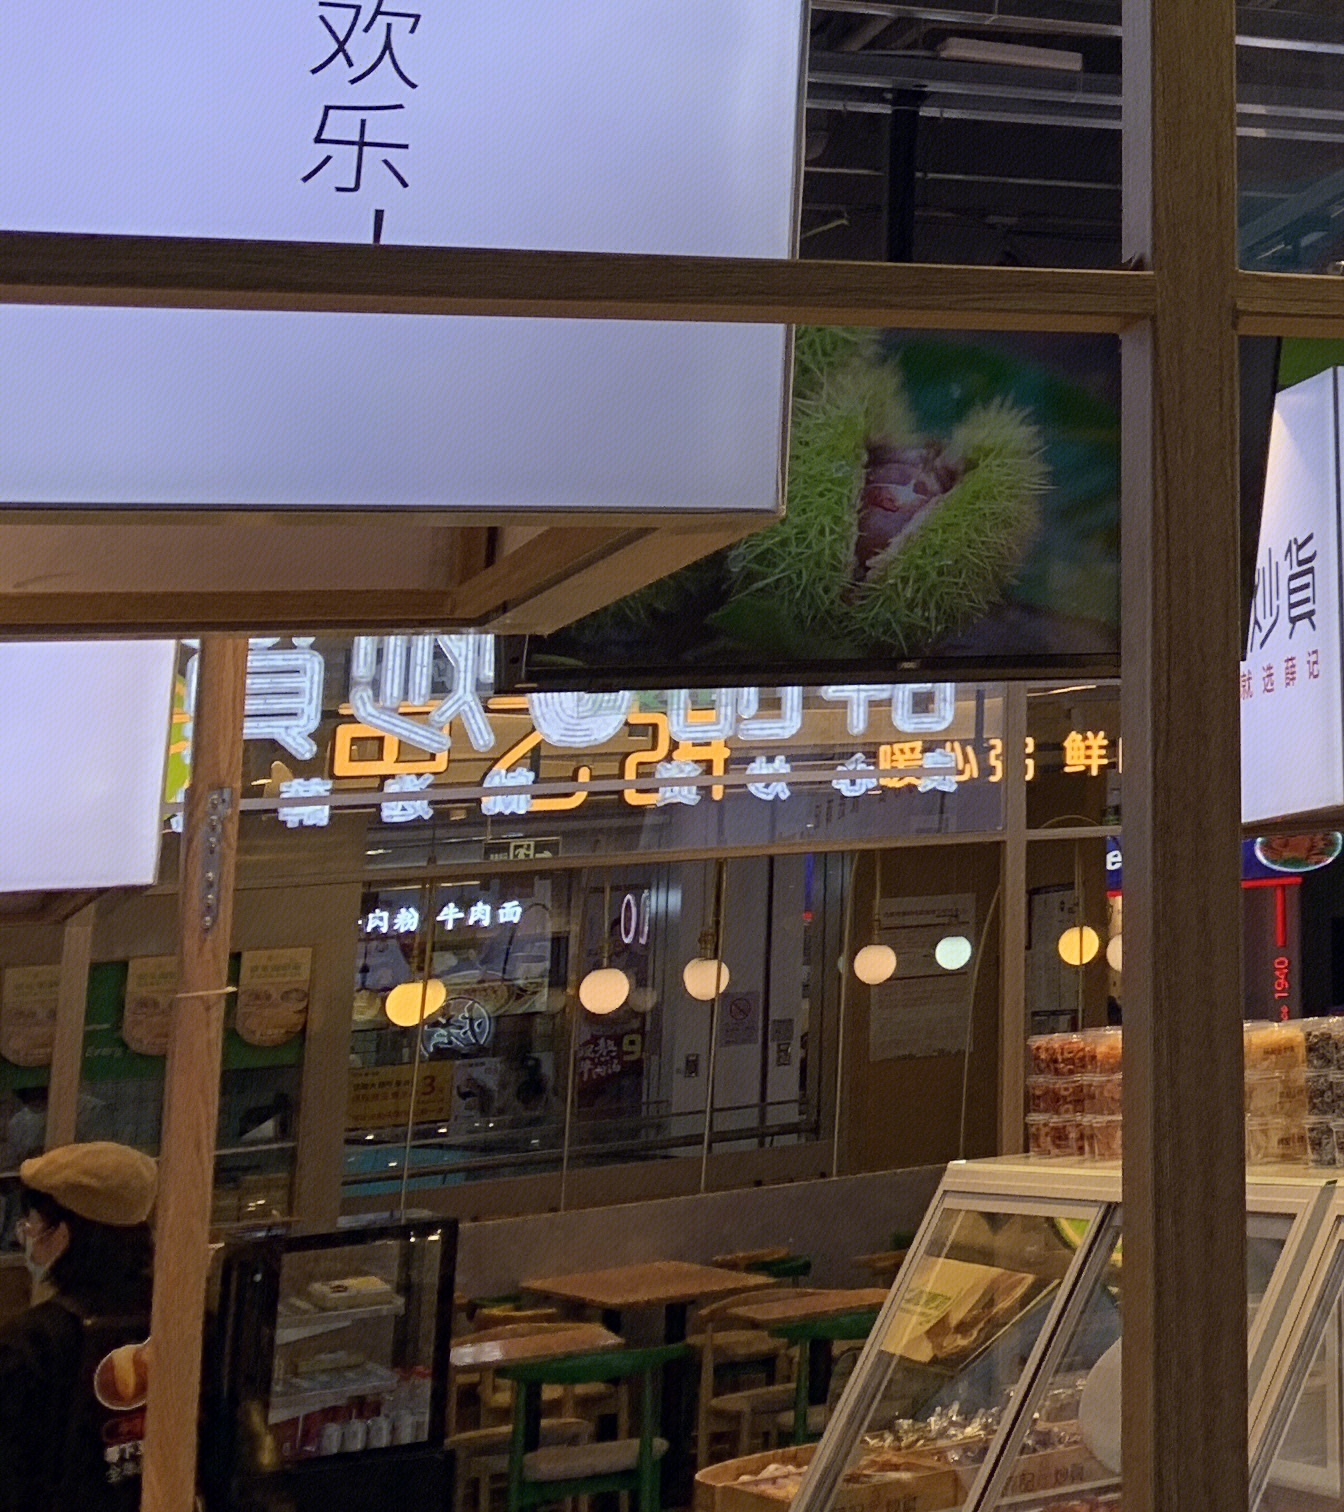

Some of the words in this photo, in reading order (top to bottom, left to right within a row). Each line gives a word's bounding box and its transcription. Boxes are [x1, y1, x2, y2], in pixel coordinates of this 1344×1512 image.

[436, 899, 524, 931] 牛肉面
[1273, 956, 1289, 1000] 1940
